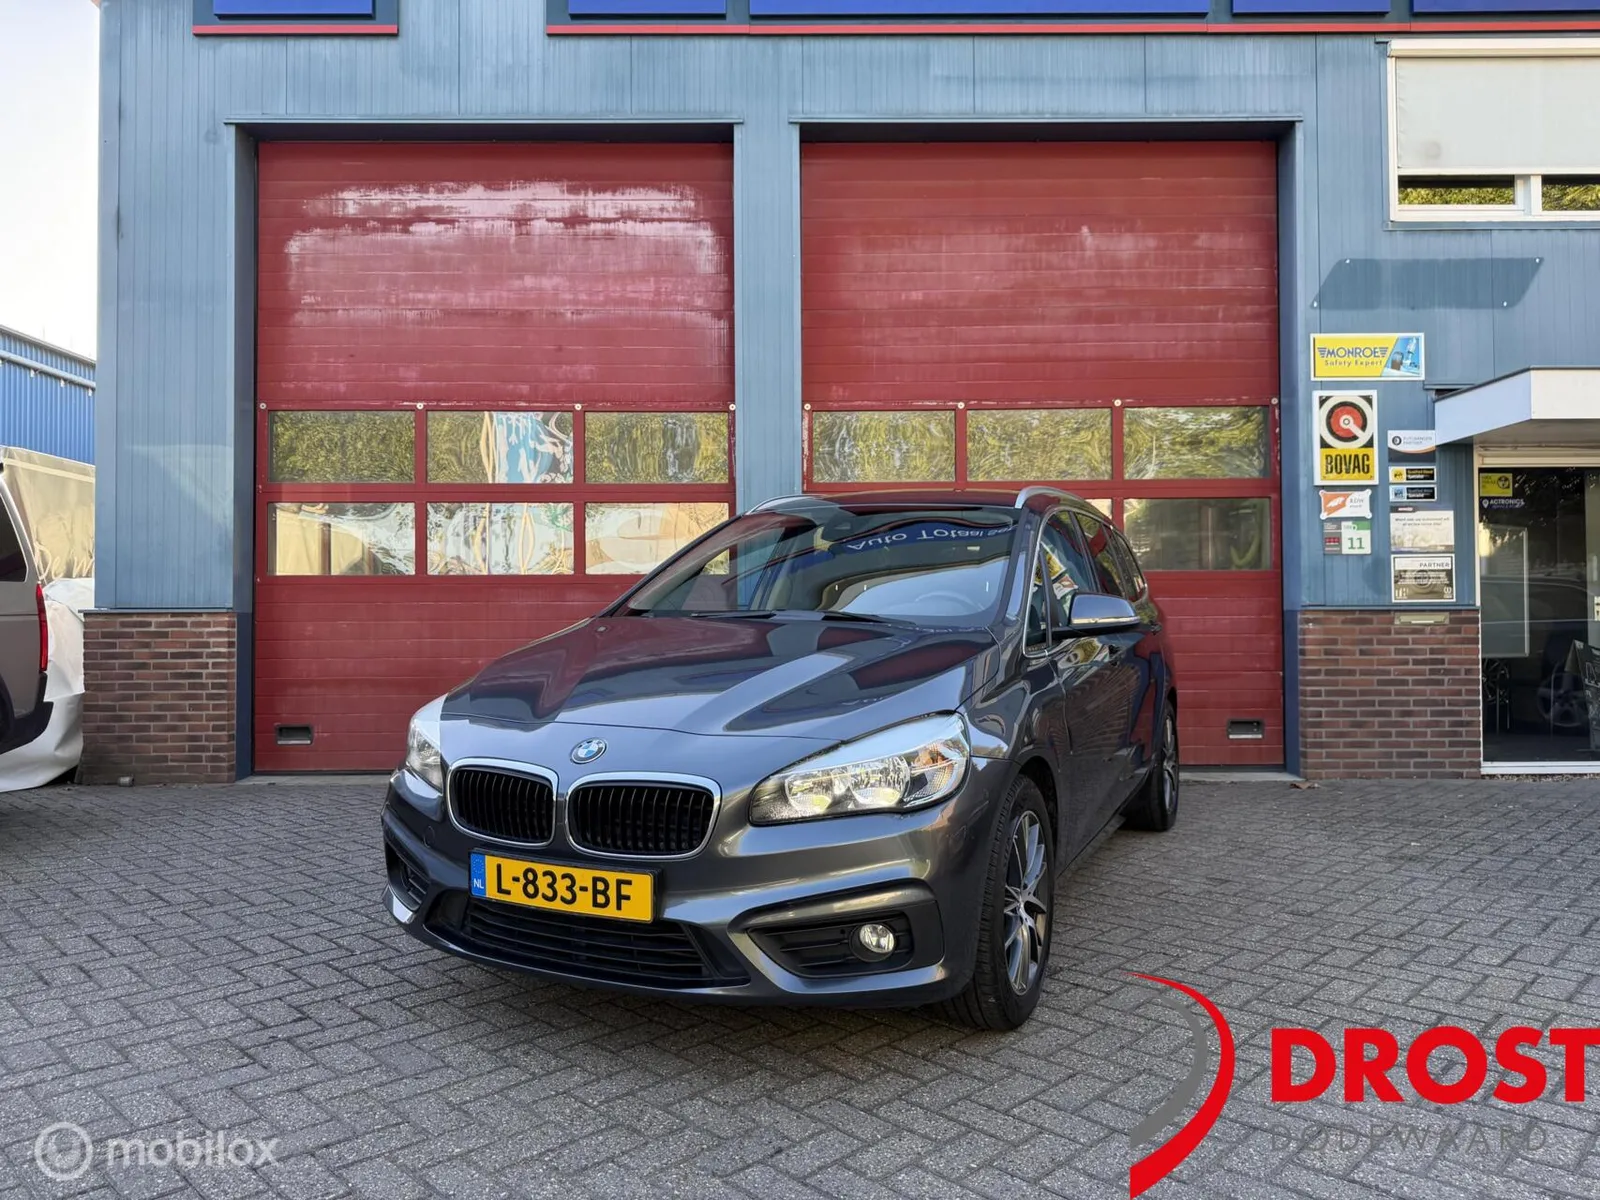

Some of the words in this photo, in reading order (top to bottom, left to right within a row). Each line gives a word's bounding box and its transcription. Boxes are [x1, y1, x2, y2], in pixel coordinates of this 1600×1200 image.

[1326, 346, 1381, 358] MONROE
[1324, 359, 1352, 367] Safety
[1354, 359, 1383, 367] Expert
[1324, 453, 1370, 475] BOVAG
[1347, 537, 1365, 550] 11
[473, 878, 485, 889] NL
[495, 863, 633, 911] L-833-BF
